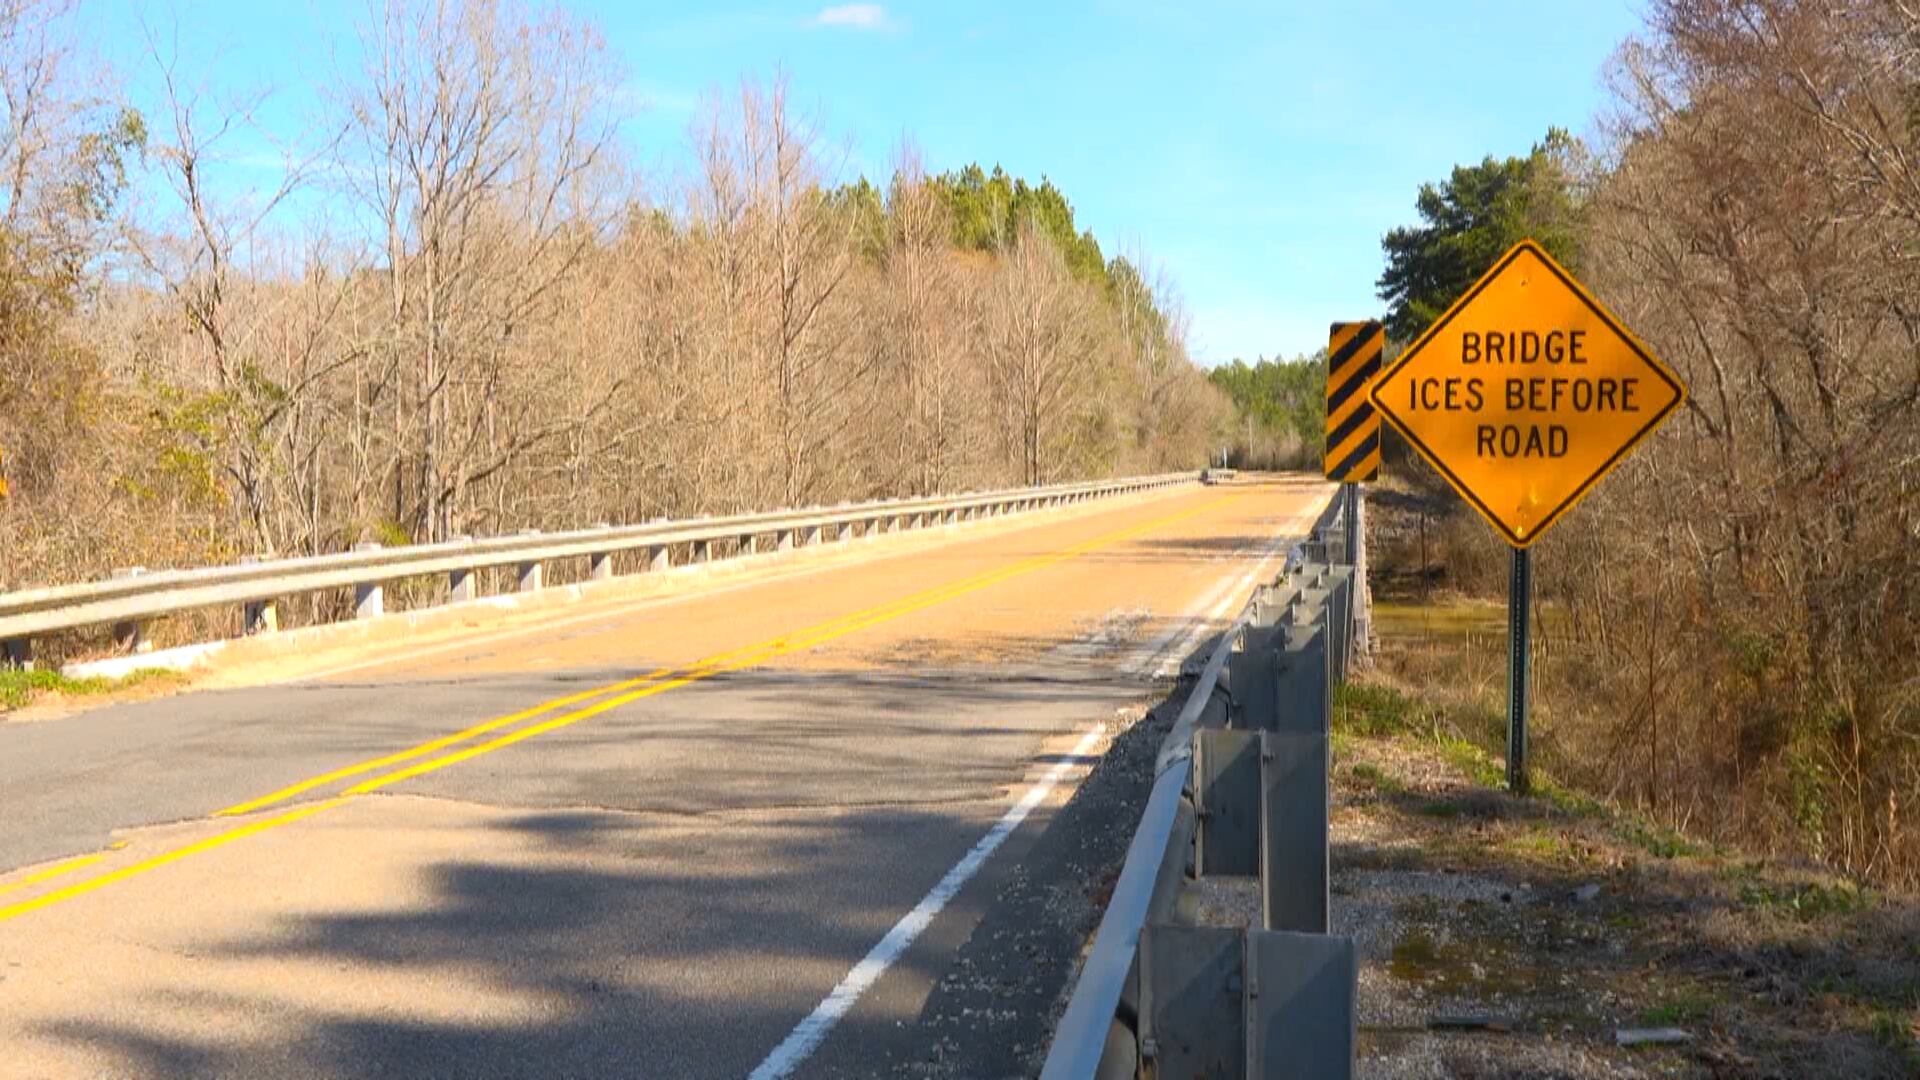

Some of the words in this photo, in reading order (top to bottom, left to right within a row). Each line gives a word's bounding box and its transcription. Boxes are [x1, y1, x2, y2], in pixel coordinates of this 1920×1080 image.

[1462, 330, 1587, 364] BRIDGE
[1409, 378, 1484, 412] ICES
[1505, 377, 1640, 412] BEFORE
[1476, 424, 1569, 458] ROAD
